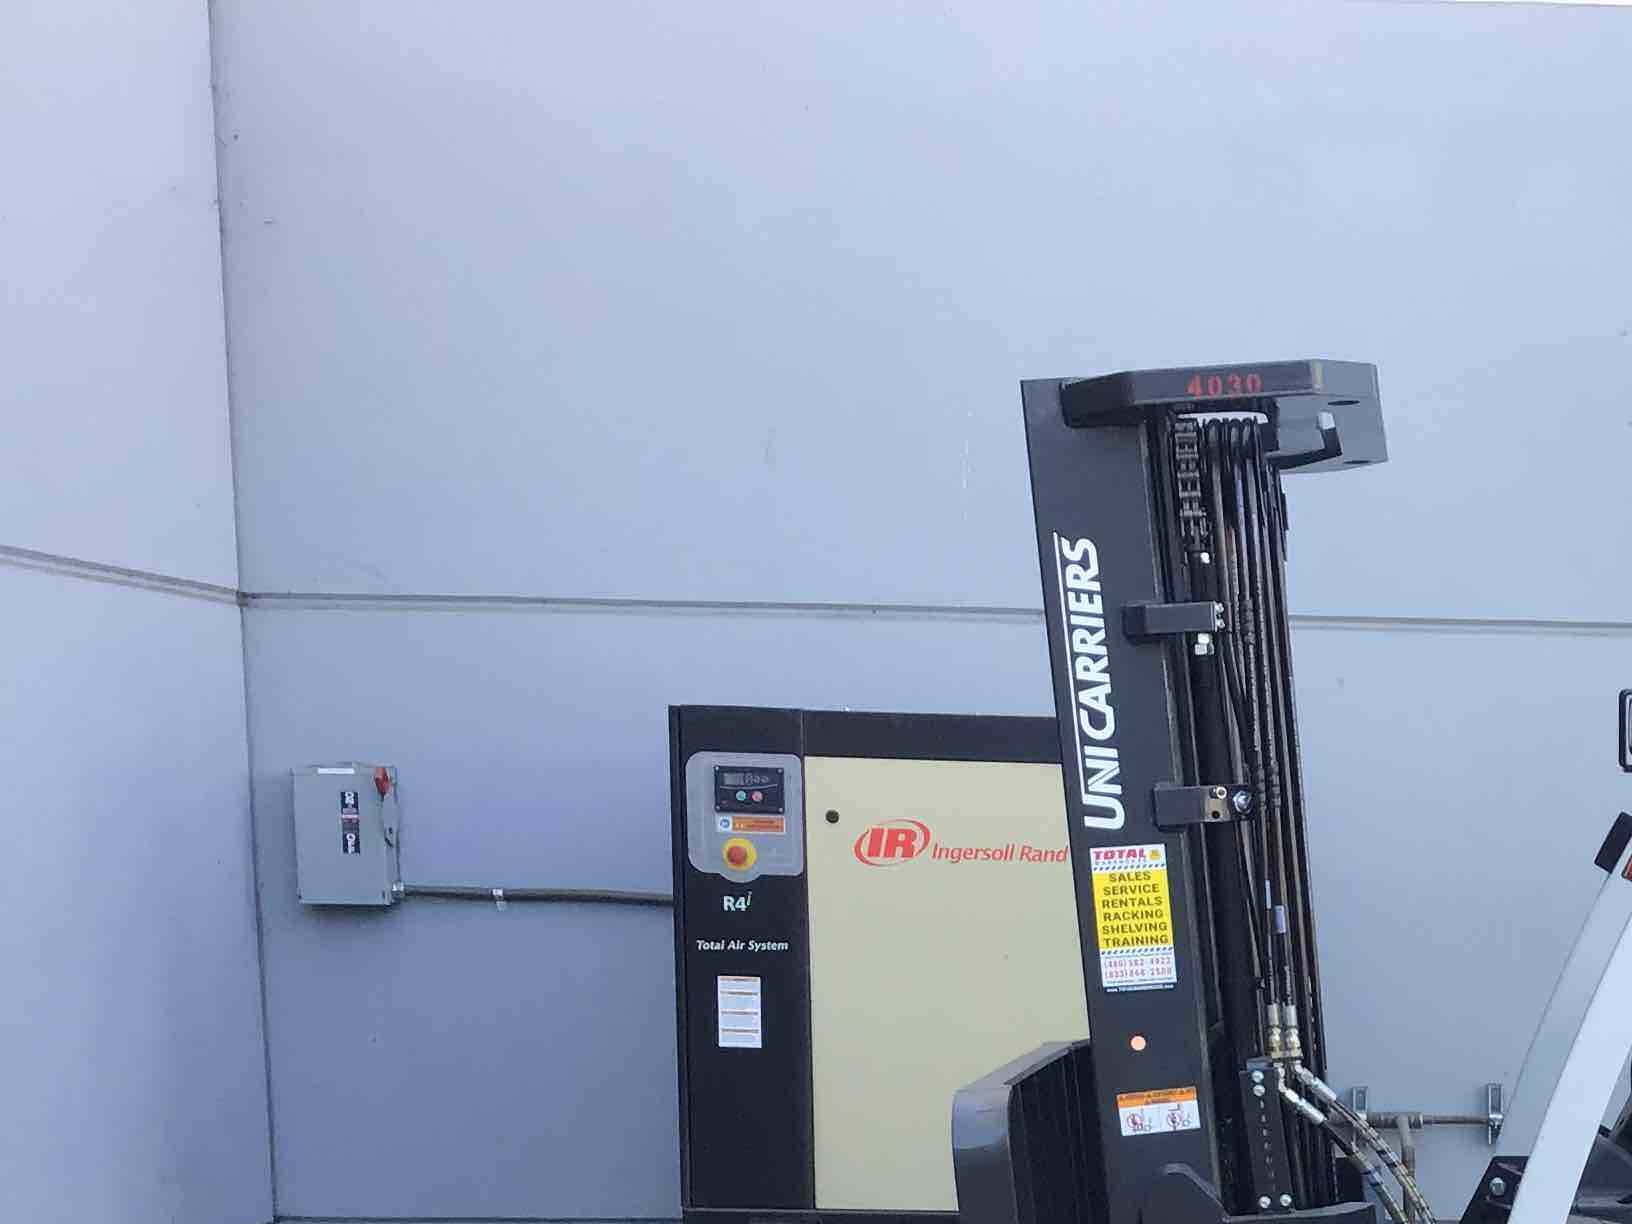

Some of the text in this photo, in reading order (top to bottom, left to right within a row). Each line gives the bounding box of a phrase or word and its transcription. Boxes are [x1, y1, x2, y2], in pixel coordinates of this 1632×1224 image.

[1185, 373, 1262, 399] 4030
[931, 842, 1016, 863] Ingersoll
[1018, 844, 1068, 863] Rand
[1093, 847, 1146, 860] TOTAL
[1108, 871, 1152, 883] SALES
[1103, 883, 1160, 896] SERVICE
[1101, 896, 1163, 909] RENTALS
[1103, 909, 1164, 922] RACKING
[1102, 922, 1168, 935] SHELVING
[696, 939, 790, 952] Total Air System
[1103, 935, 1169, 948] TRAINING
